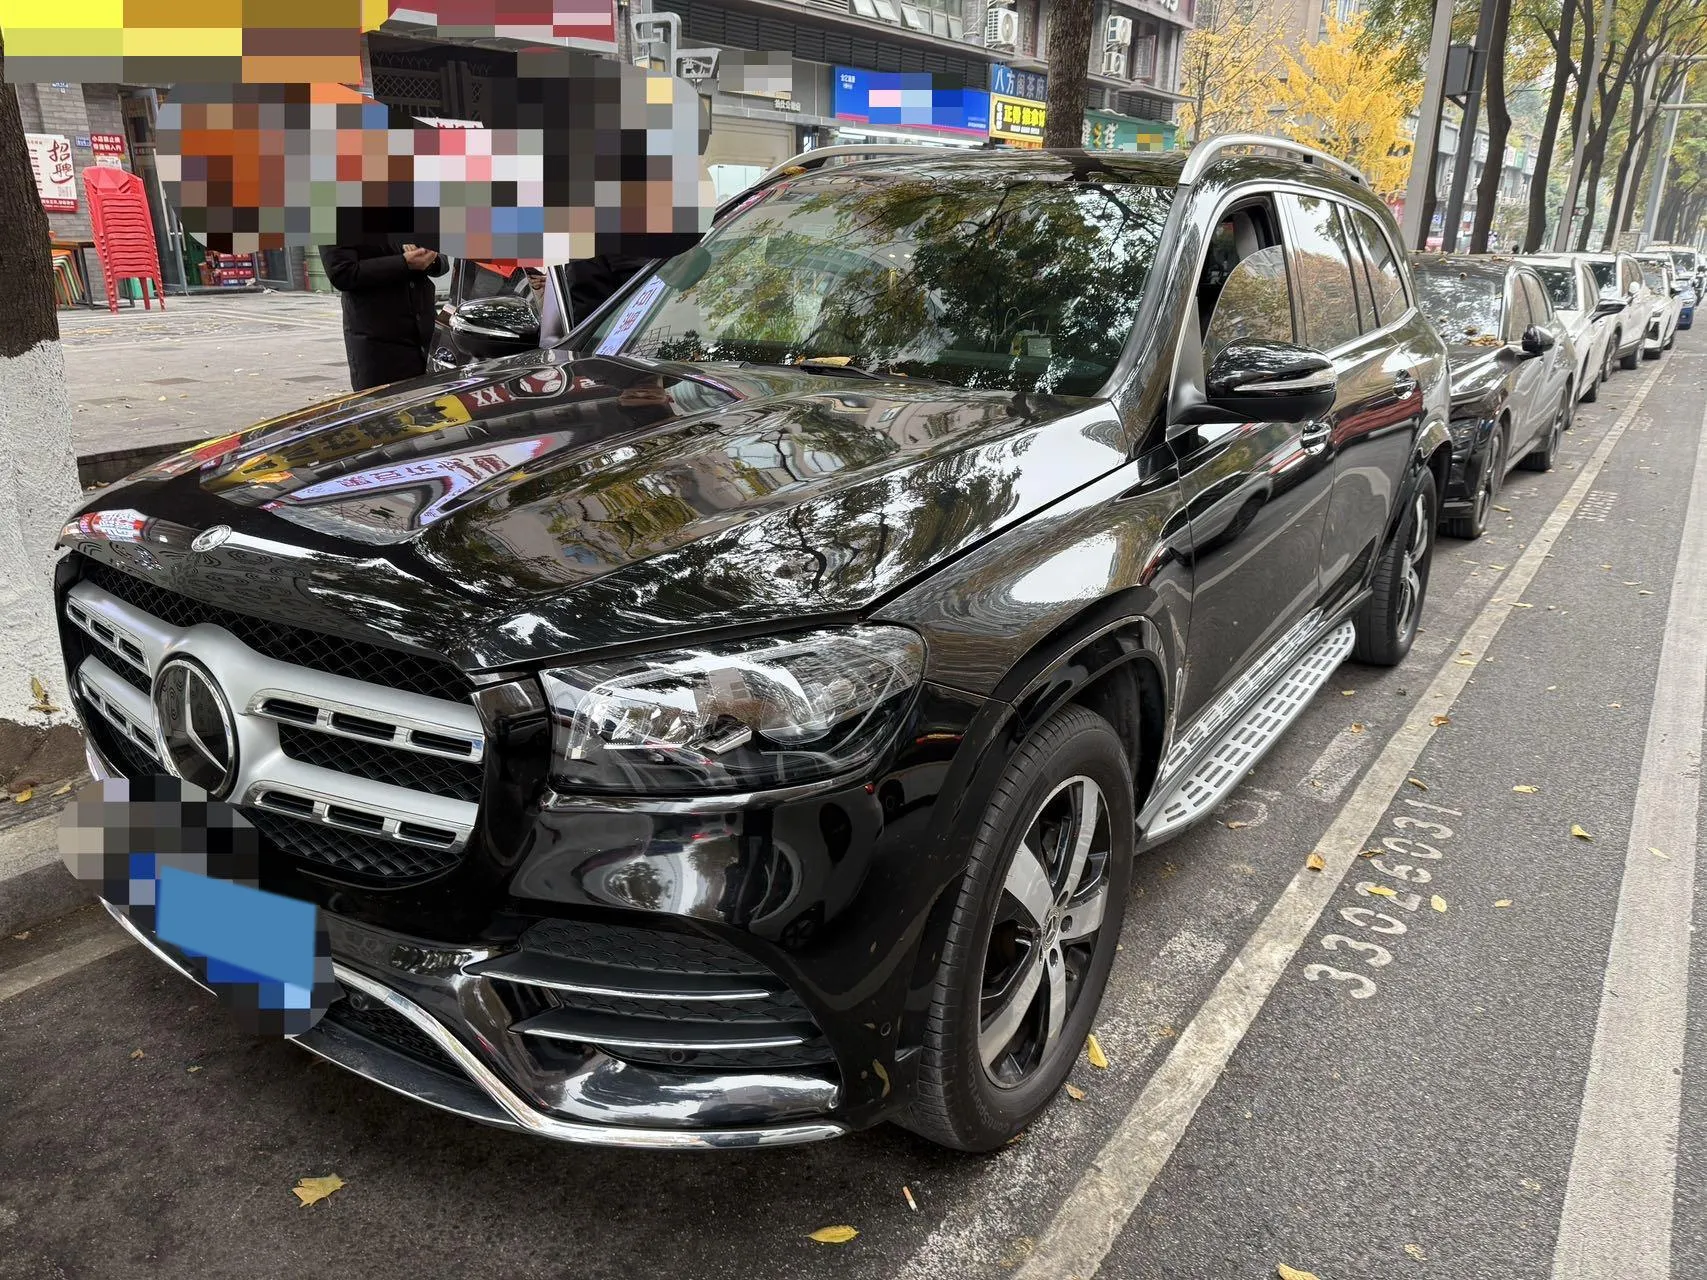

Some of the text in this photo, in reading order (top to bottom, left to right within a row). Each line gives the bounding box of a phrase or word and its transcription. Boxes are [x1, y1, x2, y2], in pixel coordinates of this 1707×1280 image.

[994, 66, 1048, 100] 八方阁茶府
[47, 139, 74, 185] 招聘
[1303, 798, 1463, 1000] 33026031
